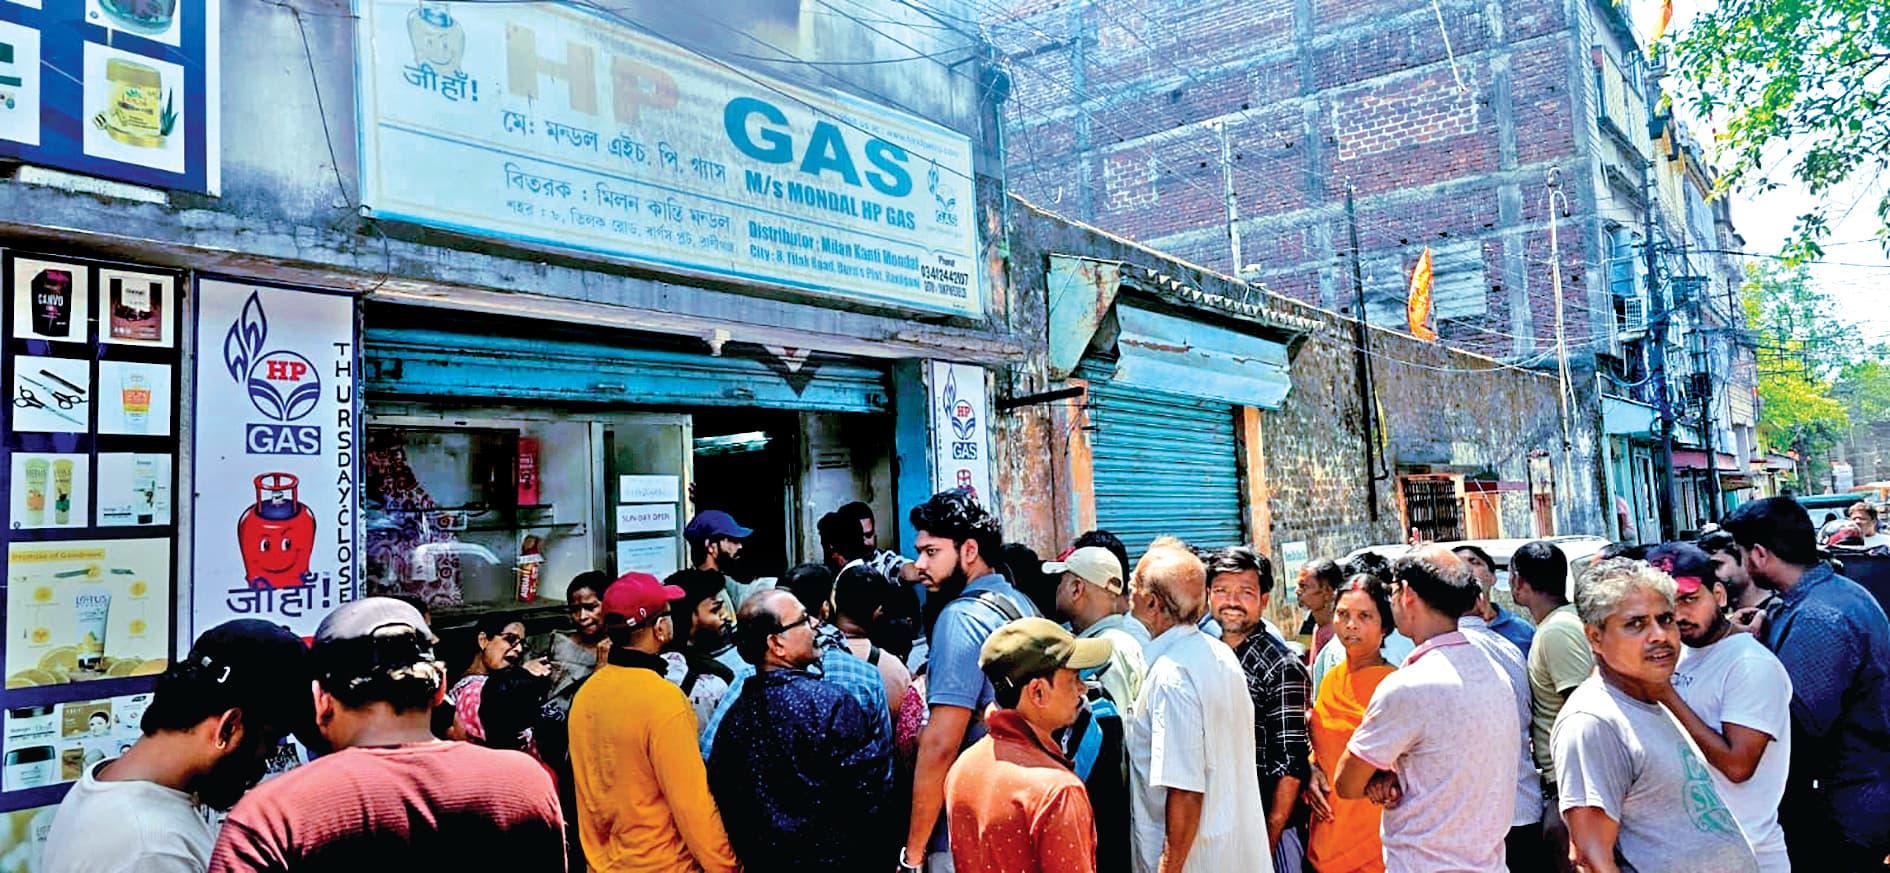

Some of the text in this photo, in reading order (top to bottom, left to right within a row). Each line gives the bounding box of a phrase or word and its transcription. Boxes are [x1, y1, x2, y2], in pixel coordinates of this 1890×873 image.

[724, 97, 913, 197] GAS
[745, 170, 916, 230] M/s MONDAL HP GAS
[749, 220, 814, 249] Distributor
[821, 237, 852, 257] Milan
[883, 249, 919, 270] Mondal
[266, 360, 307, 381] HP
[957, 405, 970, 418] HP
[248, 426, 320, 454] GAS
[953, 443, 976, 458] GAS
